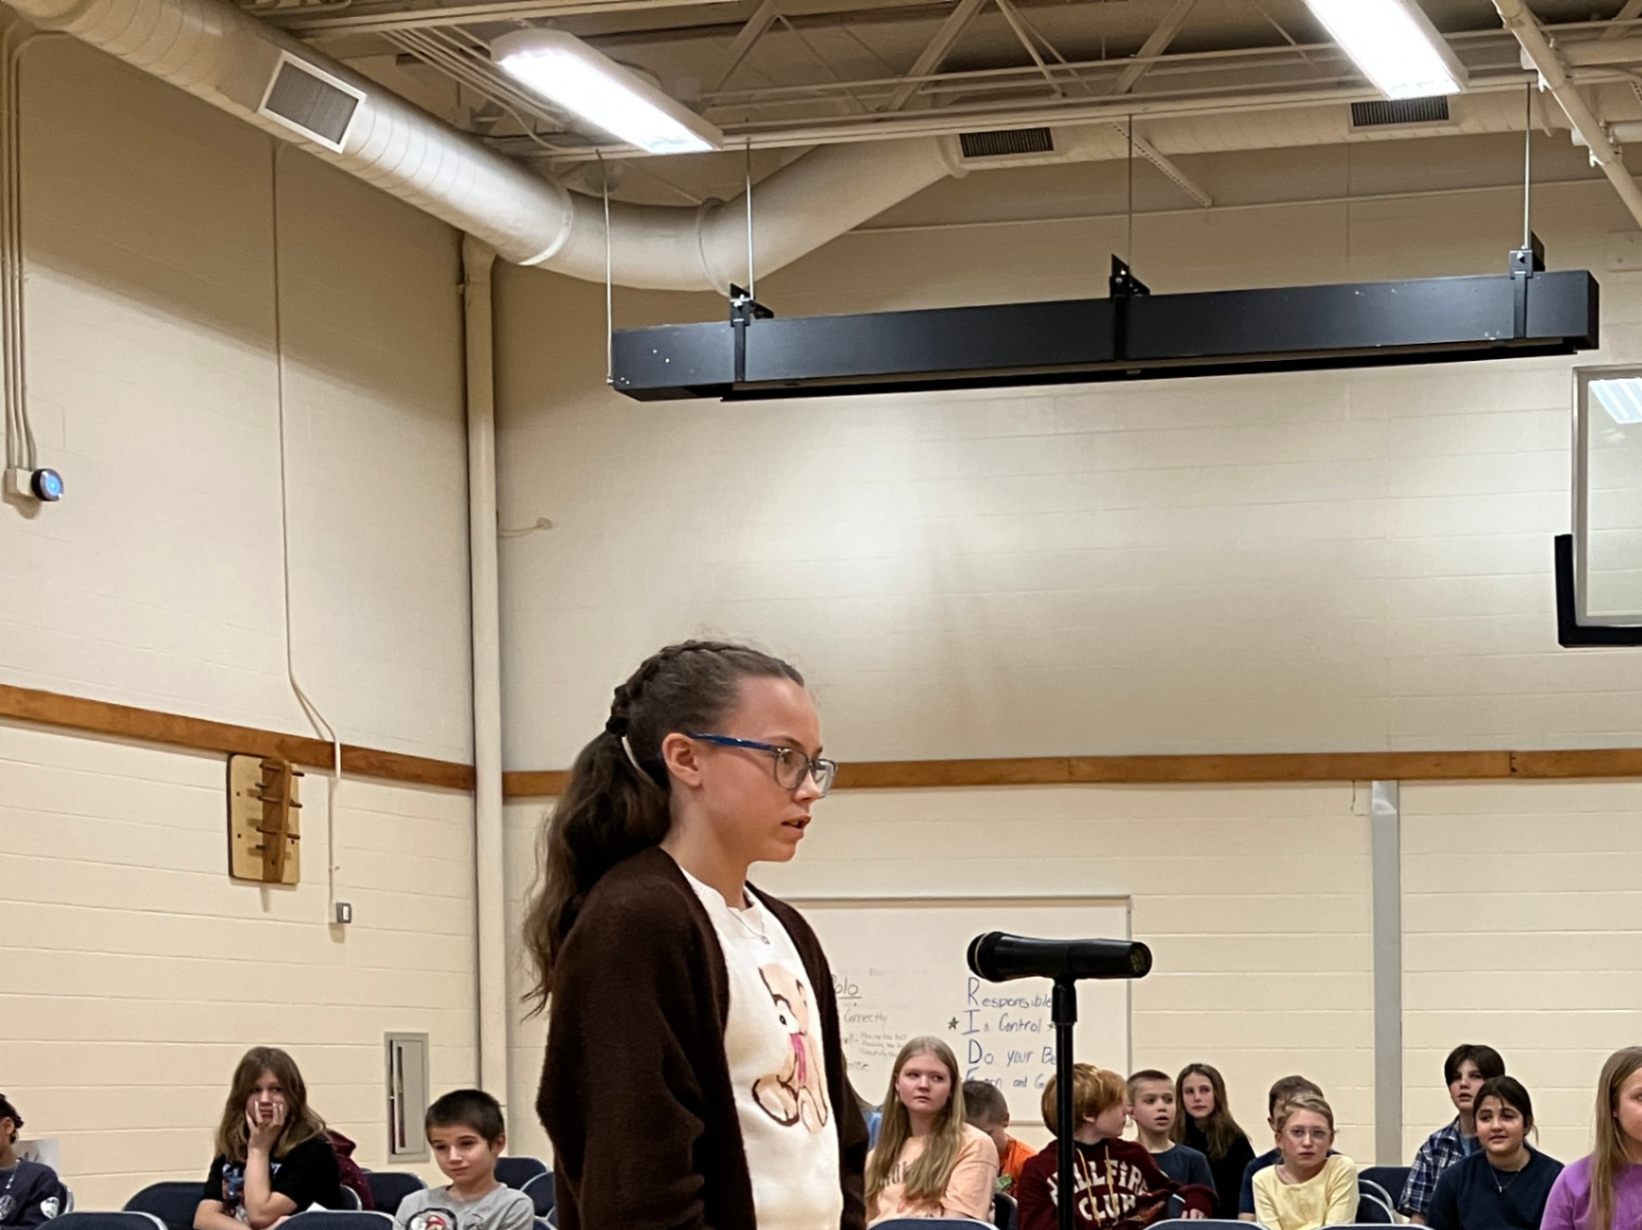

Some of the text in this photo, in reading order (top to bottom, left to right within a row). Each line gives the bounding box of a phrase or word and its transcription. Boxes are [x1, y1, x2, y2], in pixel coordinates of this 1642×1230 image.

[967, 976, 1053, 1009] Responsible
[962, 1009, 1042, 1035] In Control
[968, 1039, 1057, 1067] Do your Be
